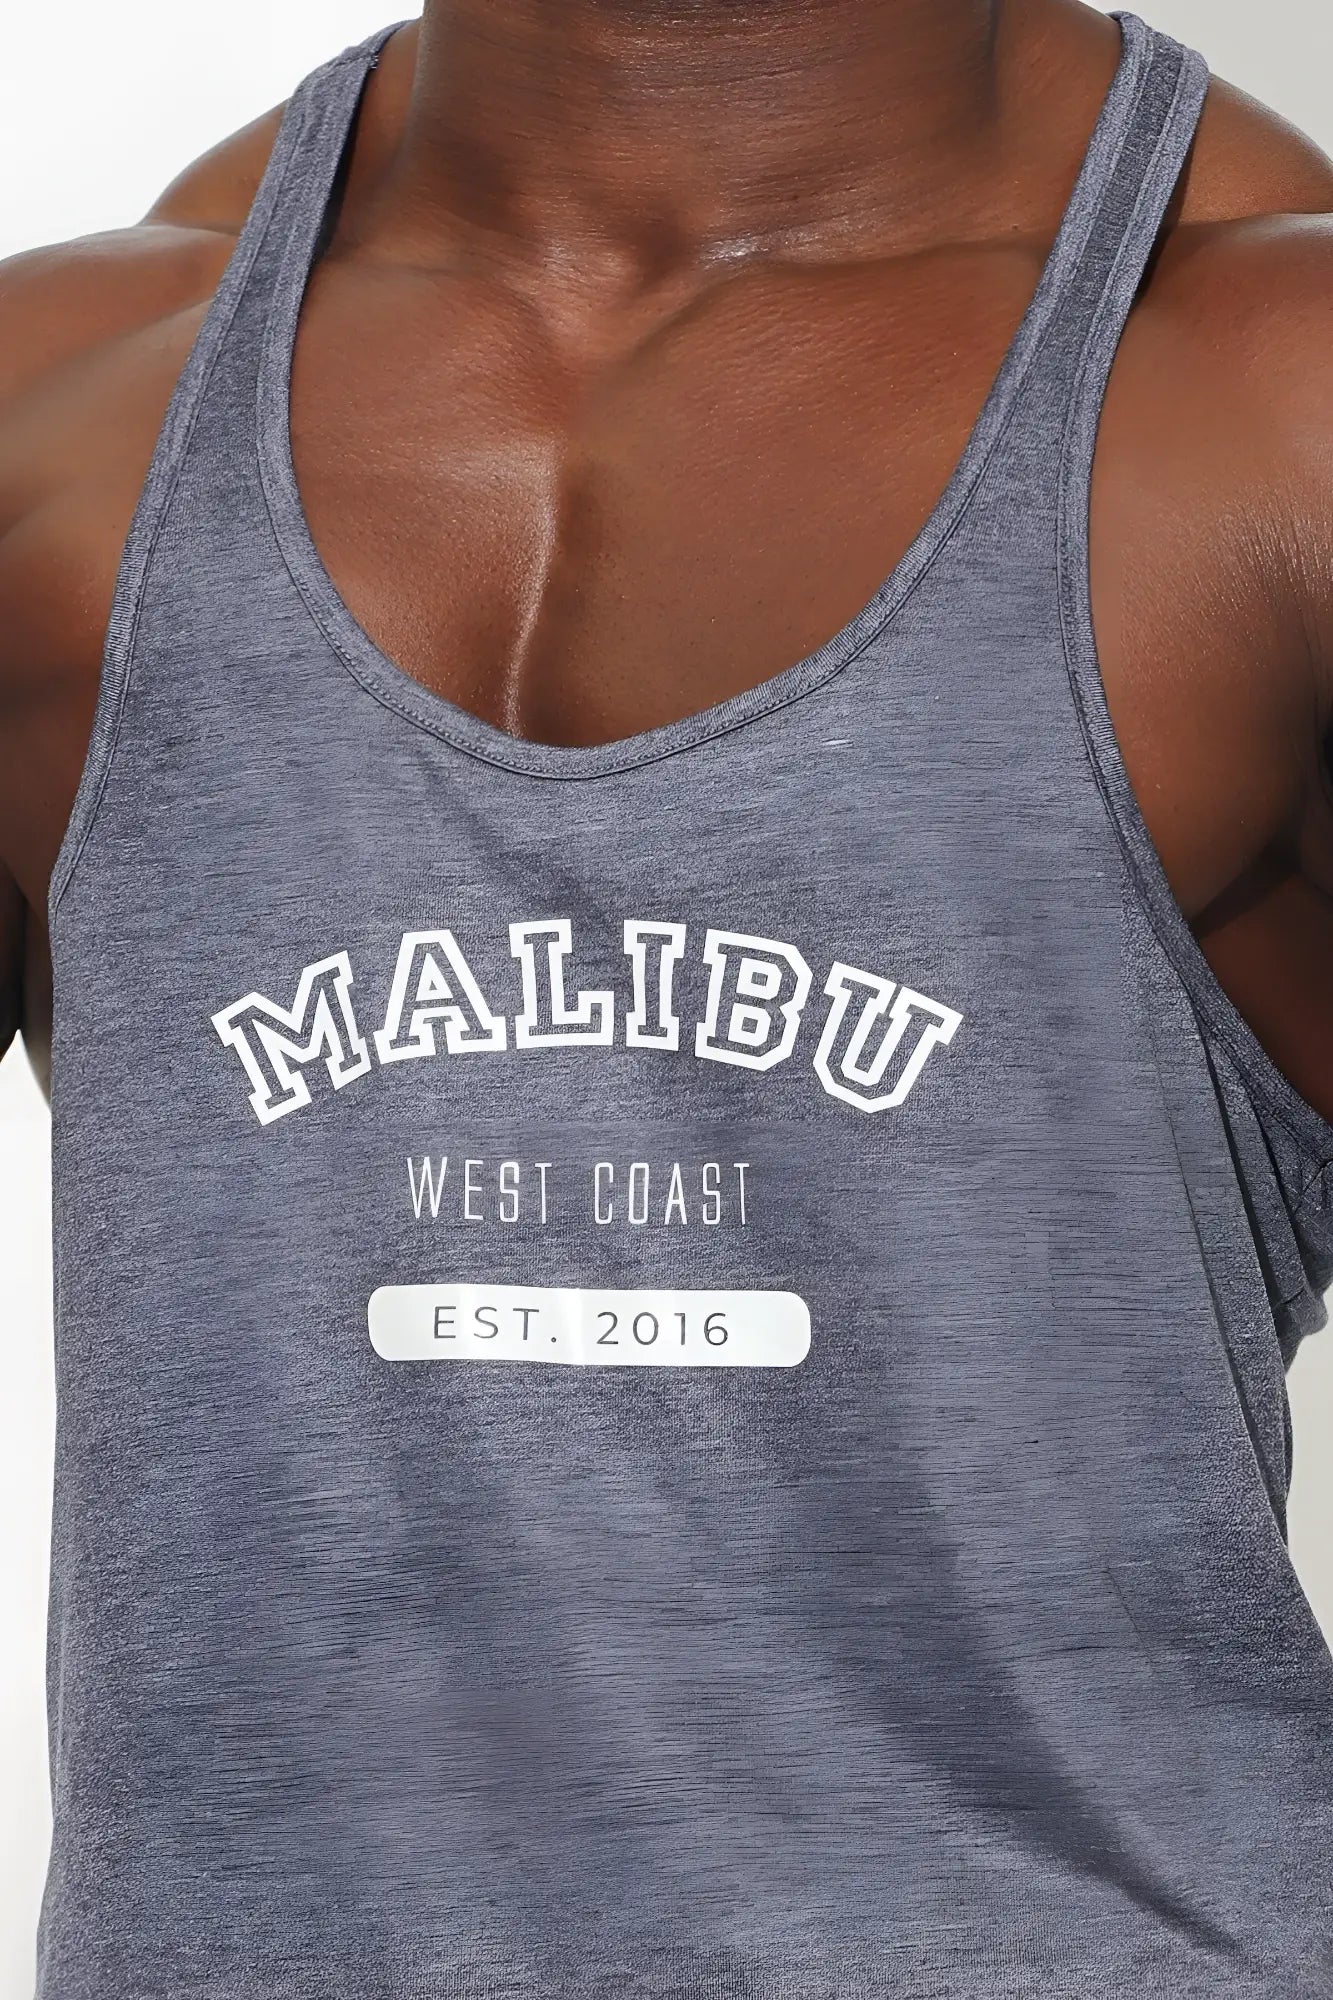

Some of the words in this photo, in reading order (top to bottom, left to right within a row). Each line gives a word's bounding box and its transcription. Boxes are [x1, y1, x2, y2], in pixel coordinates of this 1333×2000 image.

[211, 918, 962, 1126] MALIBU
[406, 1155, 552, 1225] WEST
[594, 1162, 751, 1226] COAST
[433, 1305, 559, 1344] EST.
[596, 1311, 730, 1346] 2016
